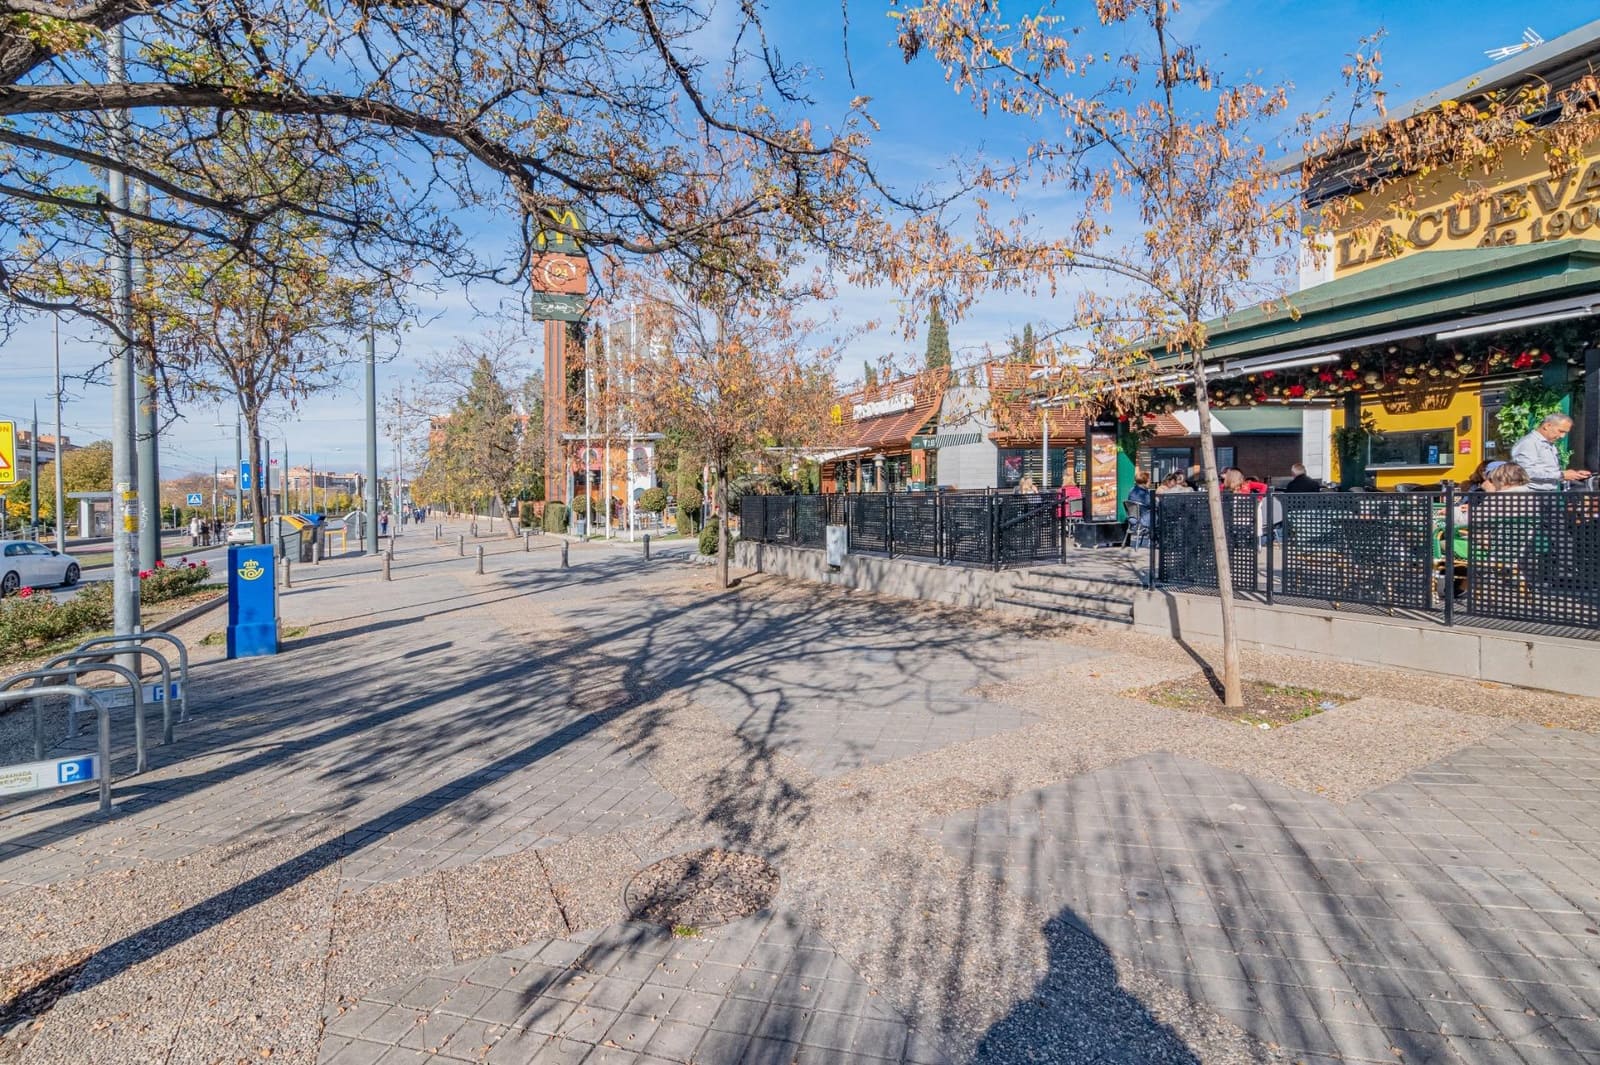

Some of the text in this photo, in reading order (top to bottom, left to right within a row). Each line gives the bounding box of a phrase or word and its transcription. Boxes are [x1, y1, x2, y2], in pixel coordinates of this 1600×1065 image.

[1338, 161, 1600, 267] LA CUEVA
[1478, 204, 1600, 248] de 190
[61, 762, 80, 782] P
